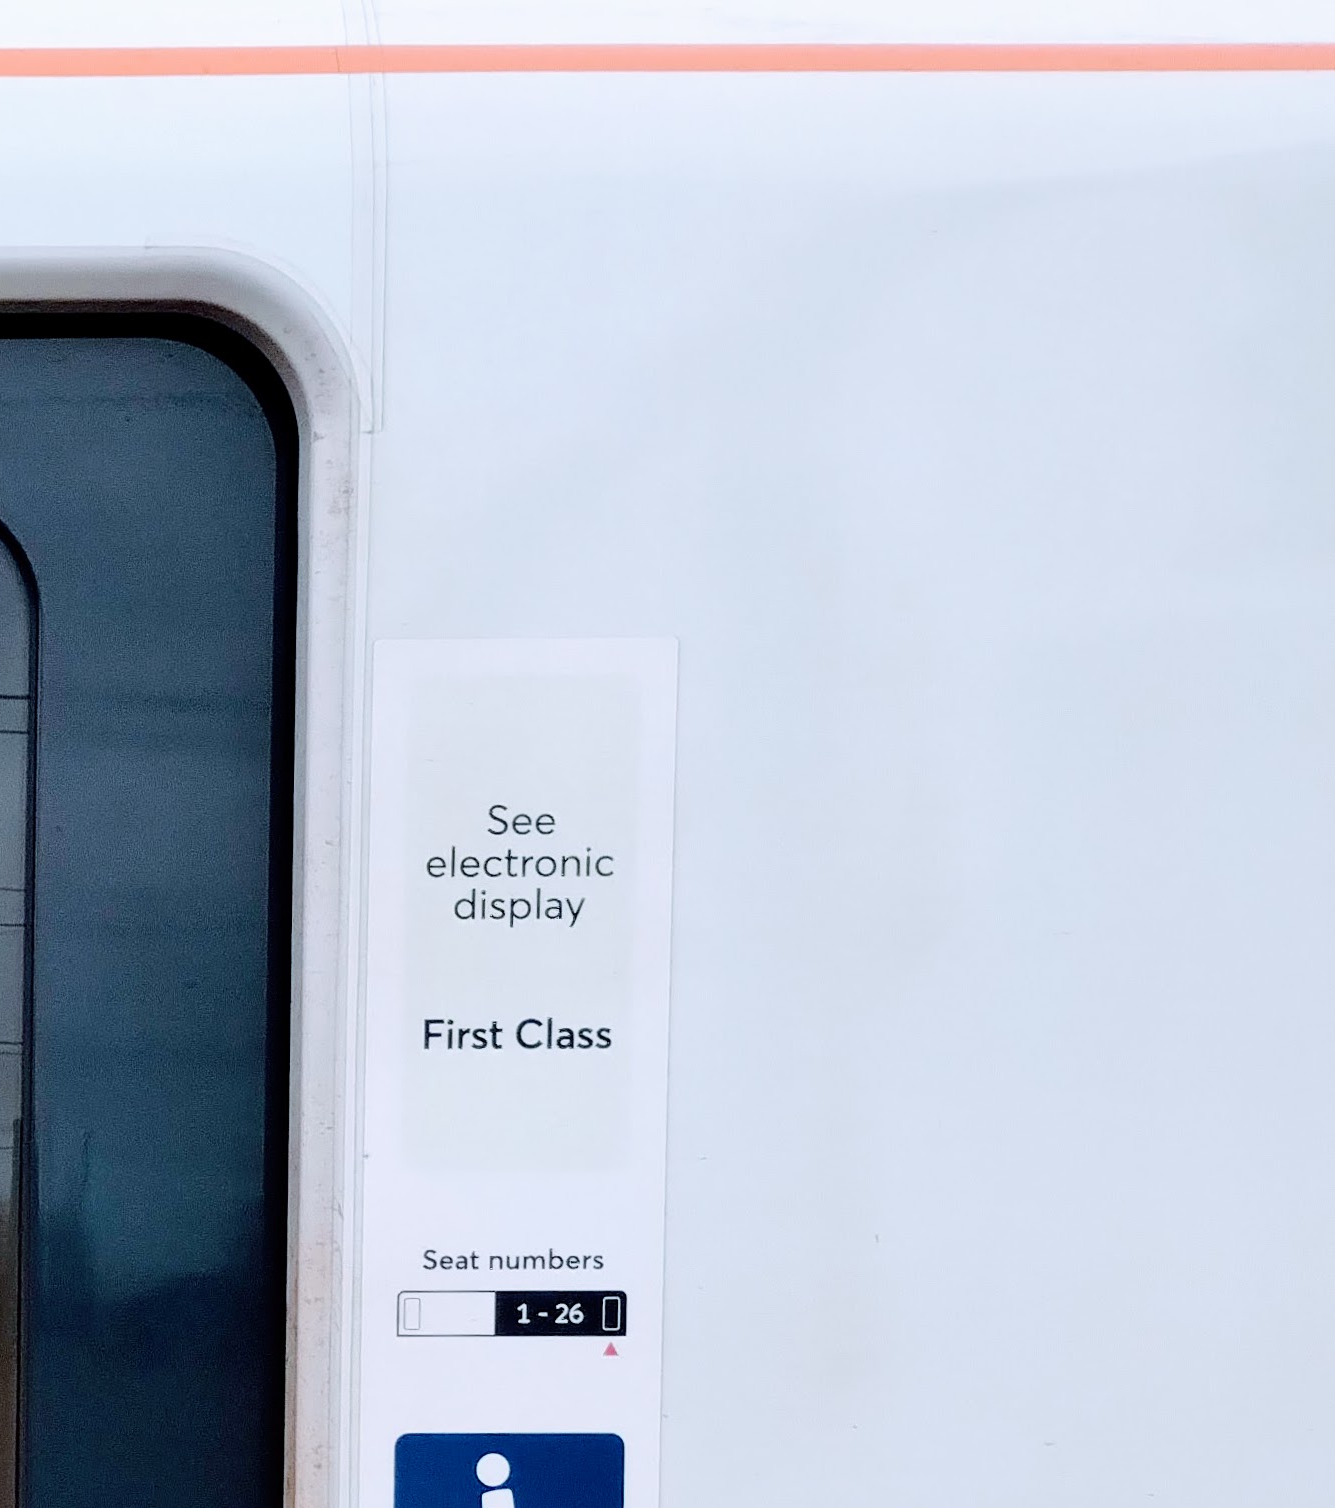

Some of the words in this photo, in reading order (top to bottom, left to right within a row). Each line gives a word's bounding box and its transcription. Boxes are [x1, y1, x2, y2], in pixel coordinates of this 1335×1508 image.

[487, 804, 557, 836] See
[426, 845, 615, 878] electronic
[453, 887, 586, 928] display
[423, 1018, 503, 1050] First
[515, 1016, 612, 1050] Class
[422, 1249, 480, 1271] Seat
[489, 1248, 605, 1270] numbers
[554, 1302, 585, 1325] 26
